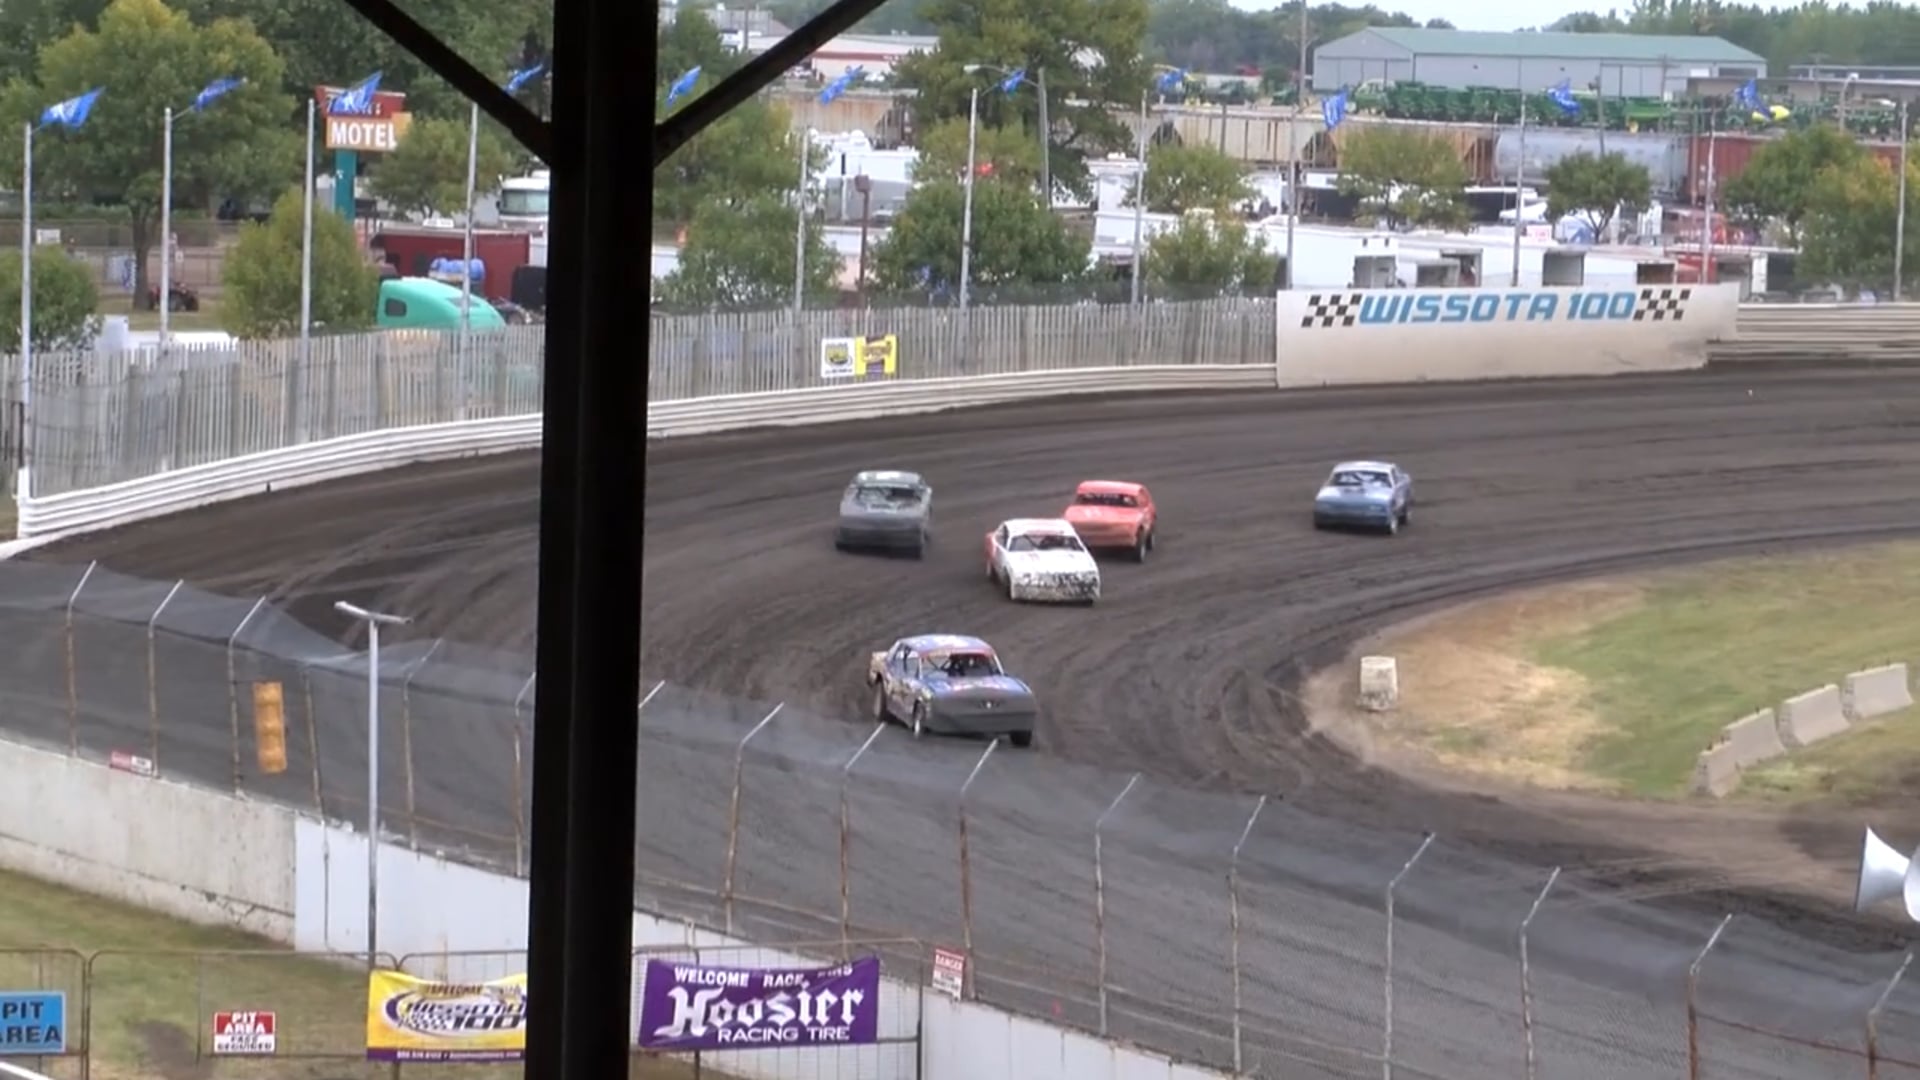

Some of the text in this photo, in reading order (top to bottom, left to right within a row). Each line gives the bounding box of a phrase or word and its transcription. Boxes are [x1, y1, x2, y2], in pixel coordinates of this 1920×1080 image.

[331, 122, 397, 149] MOTEL
[1358, 292, 1637, 324] WISSOTA 100
[674, 966, 749, 988] WELCOME
[3, 1002, 44, 1019] PIT
[653, 981, 864, 1037] Hoosier
[232, 1012, 257, 1024] PIT
[452, 1015, 521, 1030] 100
[0, 1025, 62, 1043] REA
[224, 1023, 266, 1035] AREA
[718, 1026, 850, 1042] RACING TIRE
